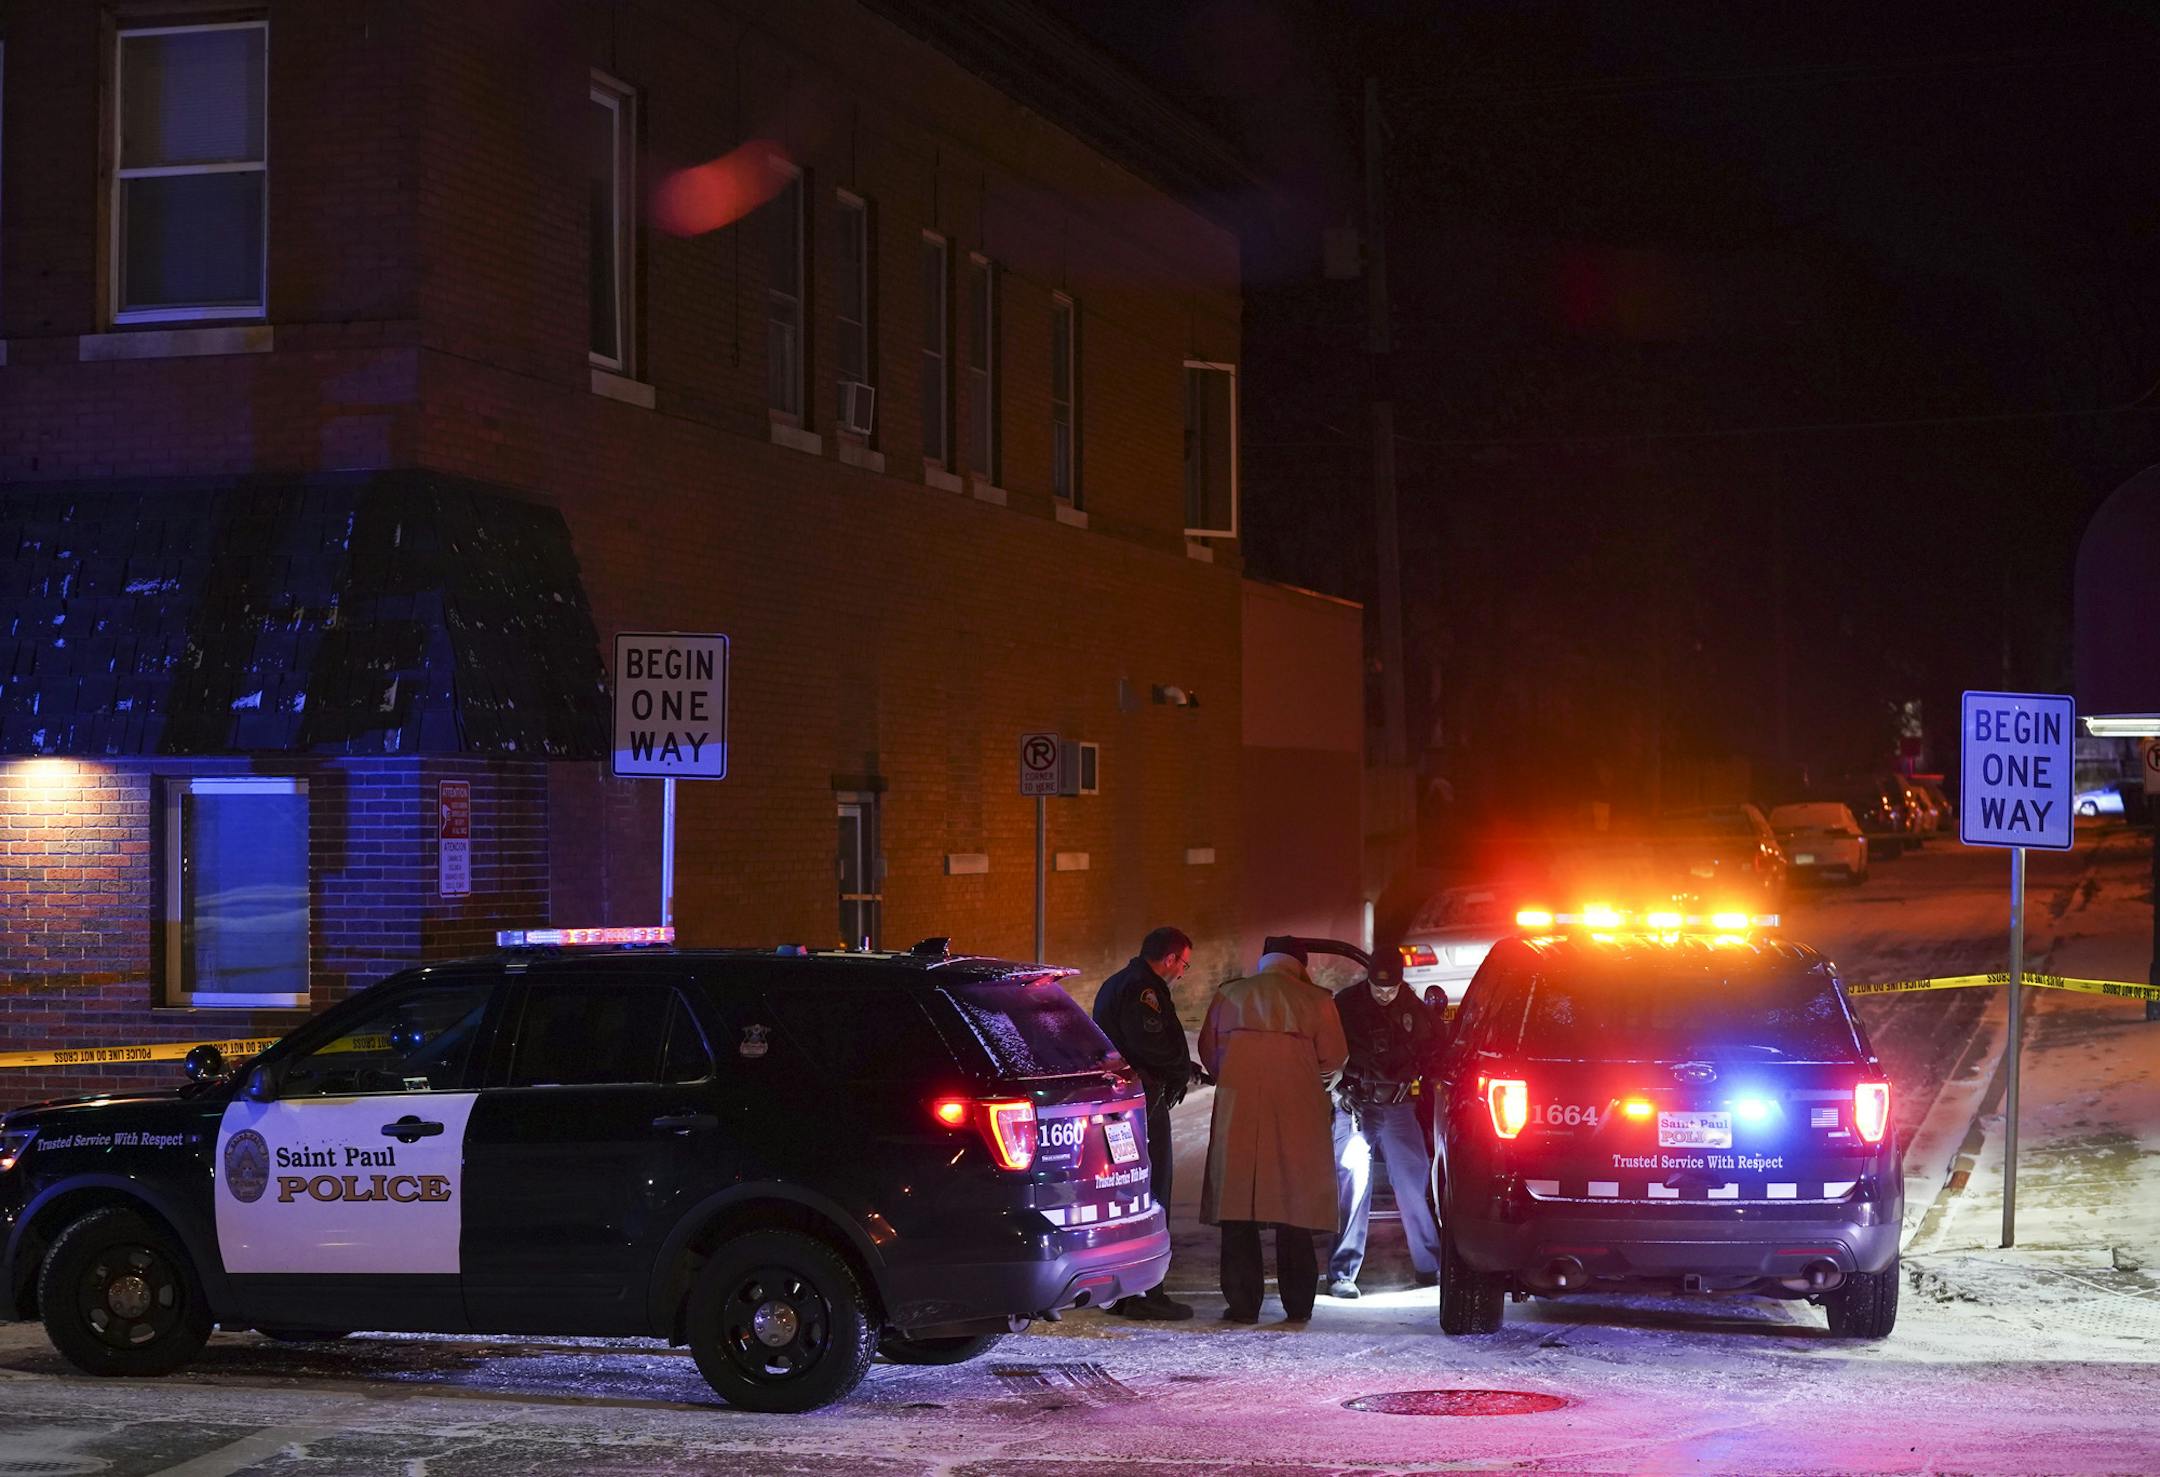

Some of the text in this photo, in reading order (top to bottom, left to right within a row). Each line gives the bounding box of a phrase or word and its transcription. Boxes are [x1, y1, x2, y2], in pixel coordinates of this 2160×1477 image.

[627, 648, 713, 680] BEGIN
[632, 689, 709, 721] ONE
[1975, 709, 2060, 745] BEGIN
[630, 731, 709, 763] WAY
[1025, 772, 1054, 781] CORNER
[1983, 753, 2052, 788] ONE
[1023, 783, 1056, 792] TO HERE
[1981, 797, 2053, 832] WAY
[1904, 978, 1930, 990] POLICE
[54, 1048, 152, 1063] POLICE LINE DO NOT CROSS
[230, 1042, 244, 1053] NOT
[246, 1042, 256, 1052] DO
[1532, 1104, 1598, 1126] 1664
[1700, 1119, 1728, 1129] Paul
[36, 1132, 184, 1151] Trusted Service With Respect
[1040, 1122, 1084, 1147] 1660
[276, 1146, 396, 1168] Saint Paul
[1612, 1154, 1783, 1172] Trusted Service With Respect
[277, 1175, 451, 1203] POLICE
